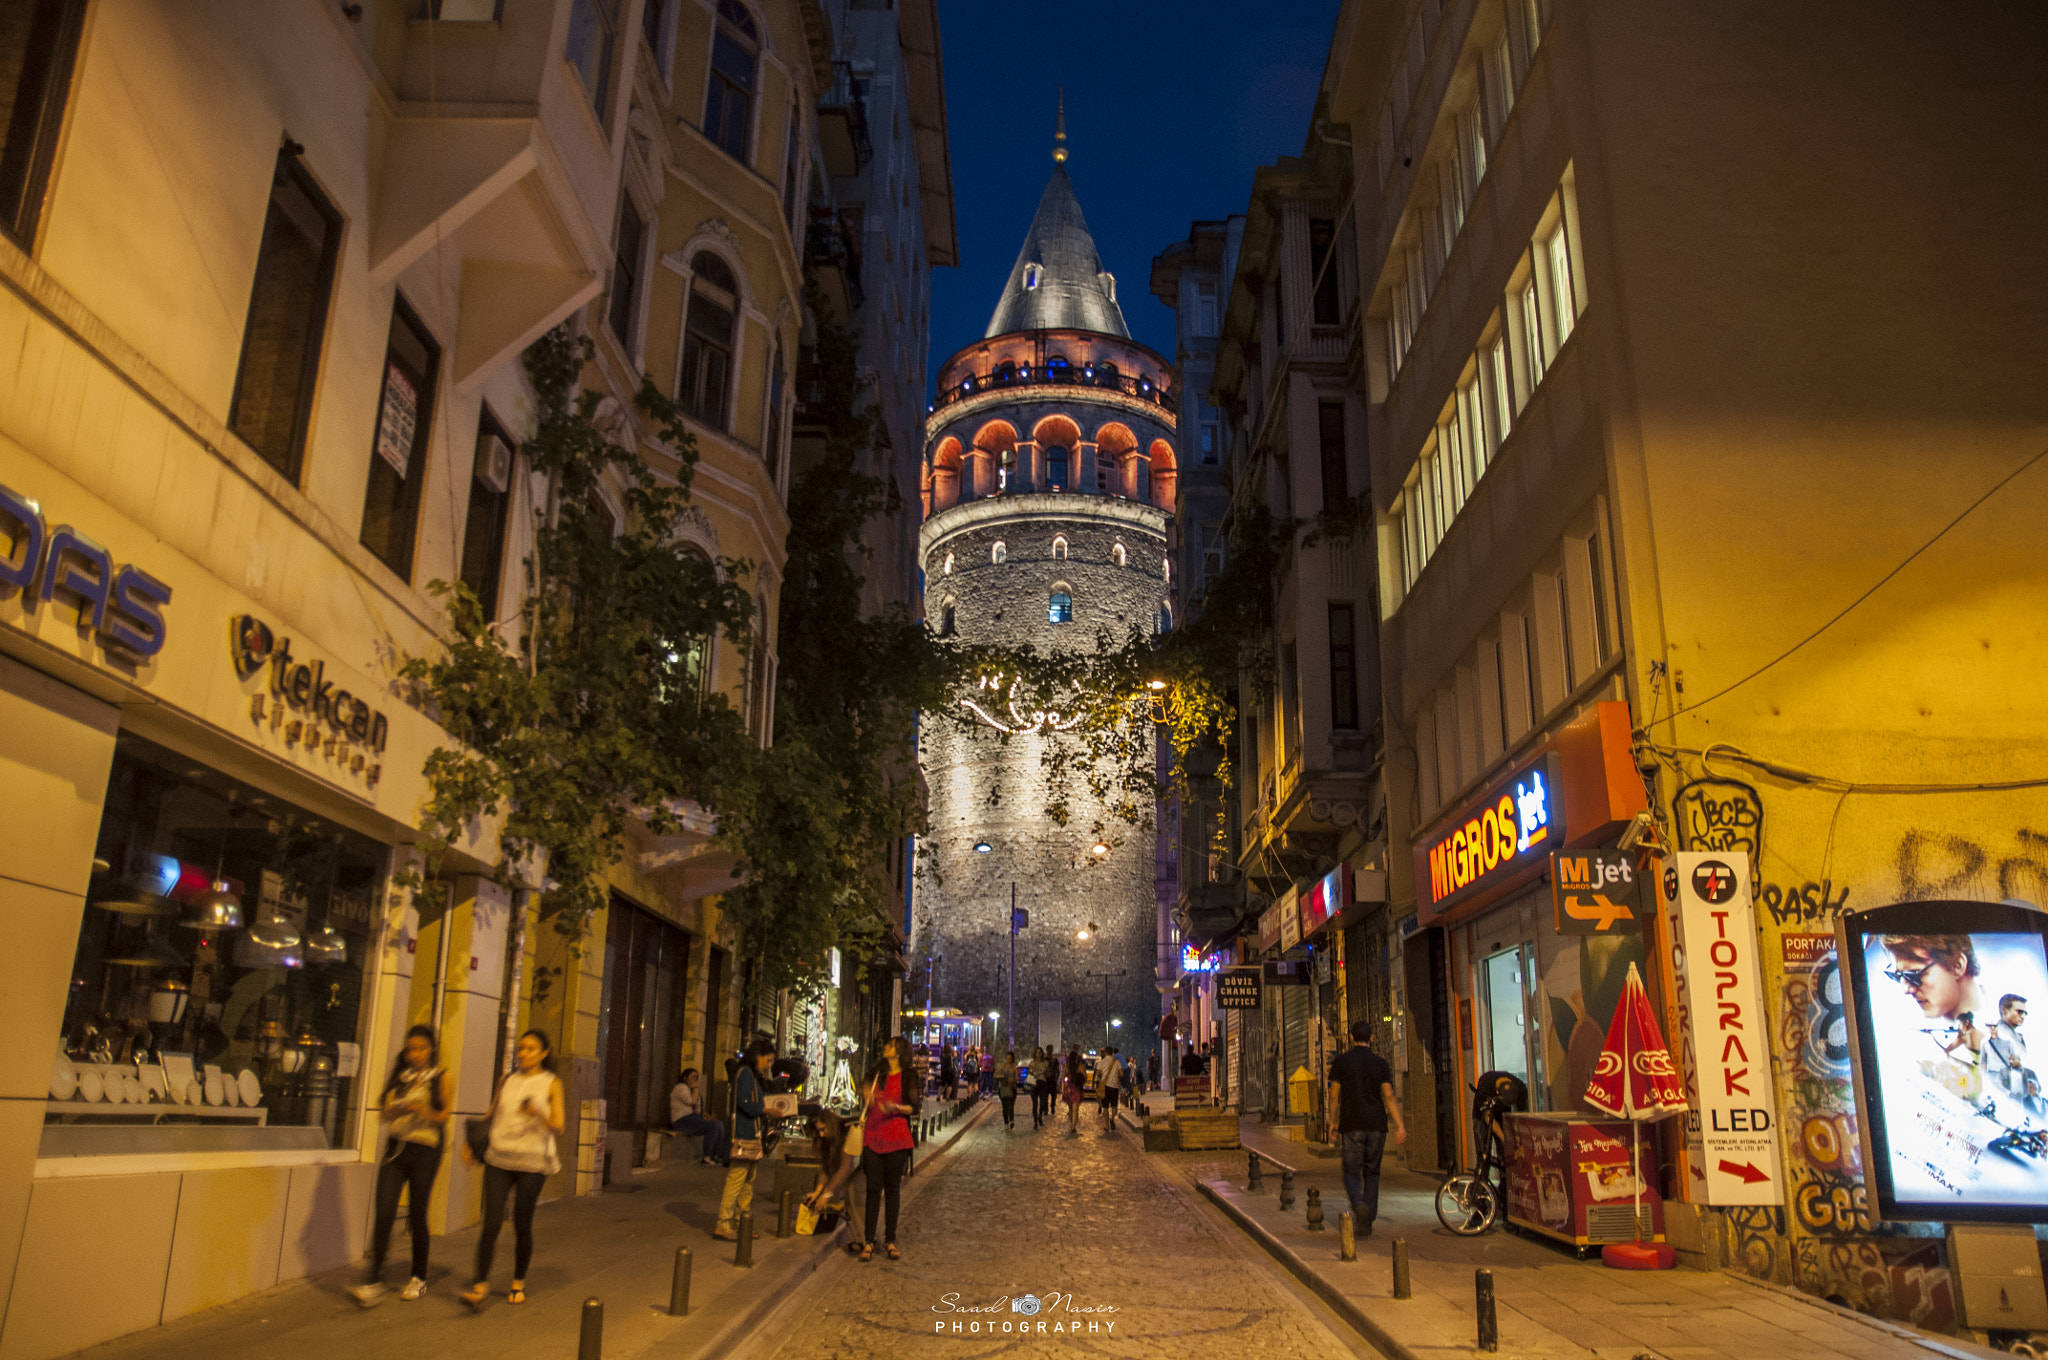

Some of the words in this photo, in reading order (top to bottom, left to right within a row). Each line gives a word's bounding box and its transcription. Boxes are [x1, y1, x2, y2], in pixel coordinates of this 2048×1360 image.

[270, 636, 388, 752] tekcan
[1517, 771, 1547, 852] jet
[1591, 857, 1632, 890] jet
[1220, 987, 1258, 996] CHANGE
[1223, 998, 1256, 1006] OFFICE
[1710, 911, 1750, 1096] TOPRAK
[1711, 1109, 1770, 1132] LED
